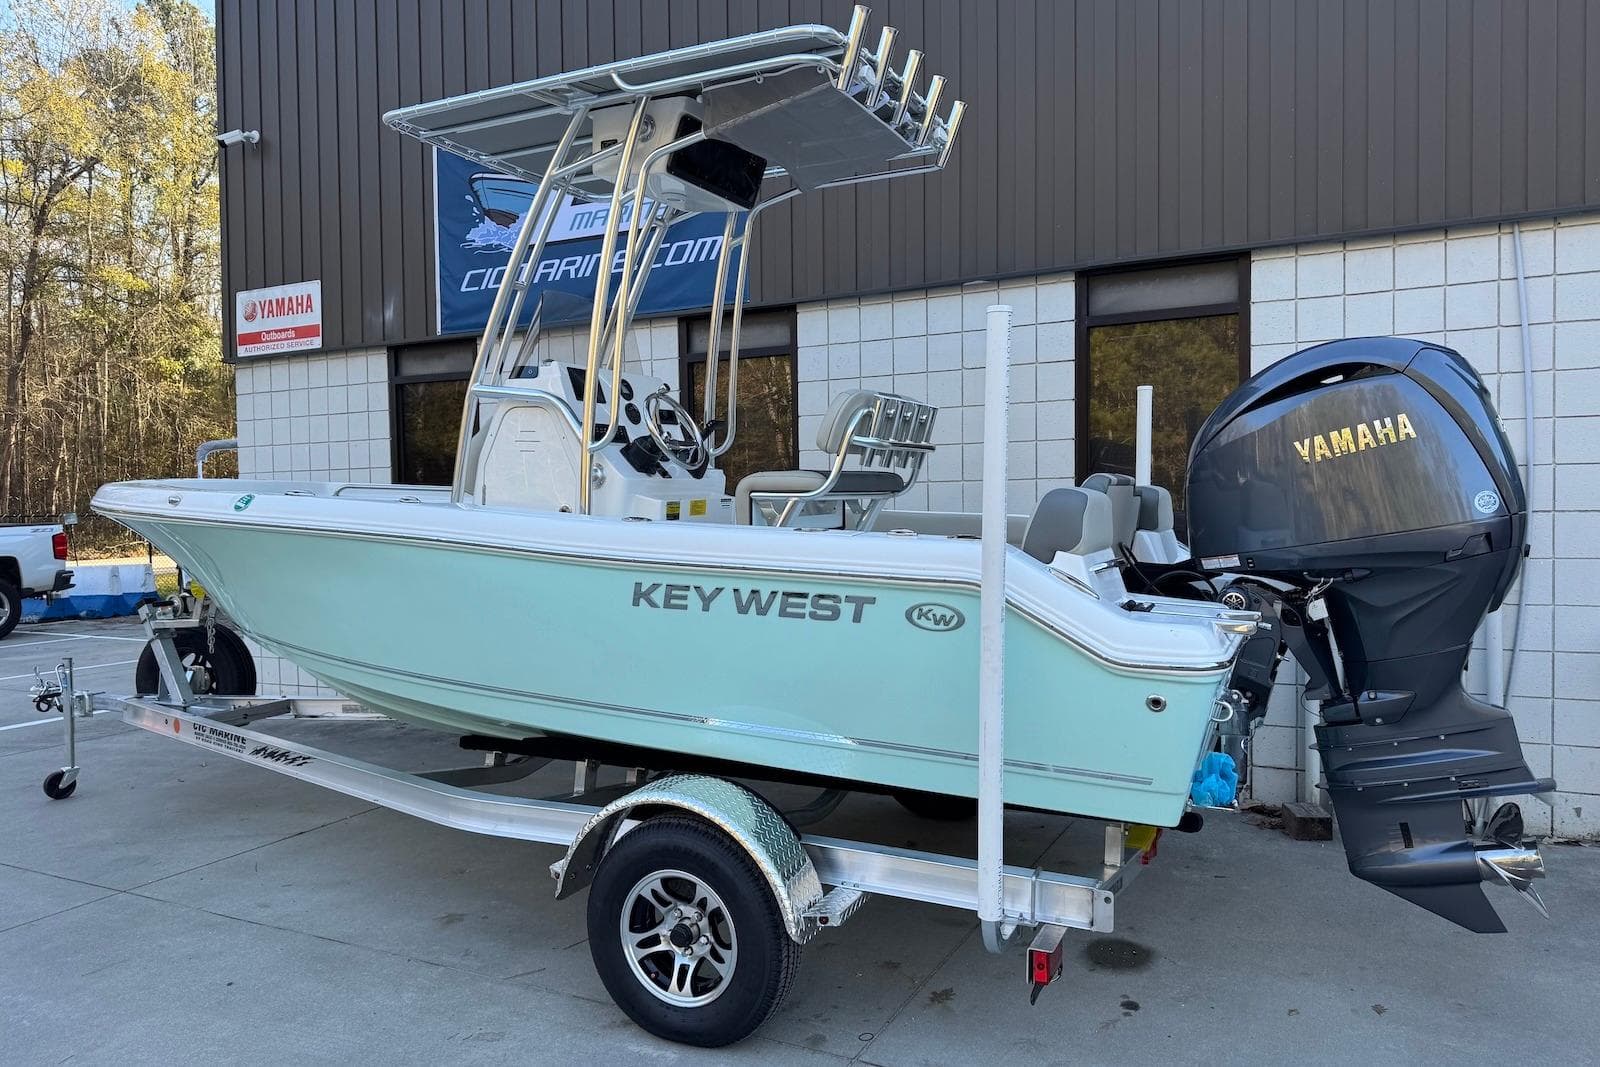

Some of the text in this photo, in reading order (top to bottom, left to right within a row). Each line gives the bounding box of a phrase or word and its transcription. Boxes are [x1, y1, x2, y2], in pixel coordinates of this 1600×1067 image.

[258, 293, 314, 319] YAMAHA
[244, 339, 314, 353] AUTHORIZED SERVICE
[261, 328, 296, 342] Outboards
[1293, 413, 1418, 463] YAMAHA
[632, 582, 877, 624] KEY WEST
[916, 605, 958, 628] KW
